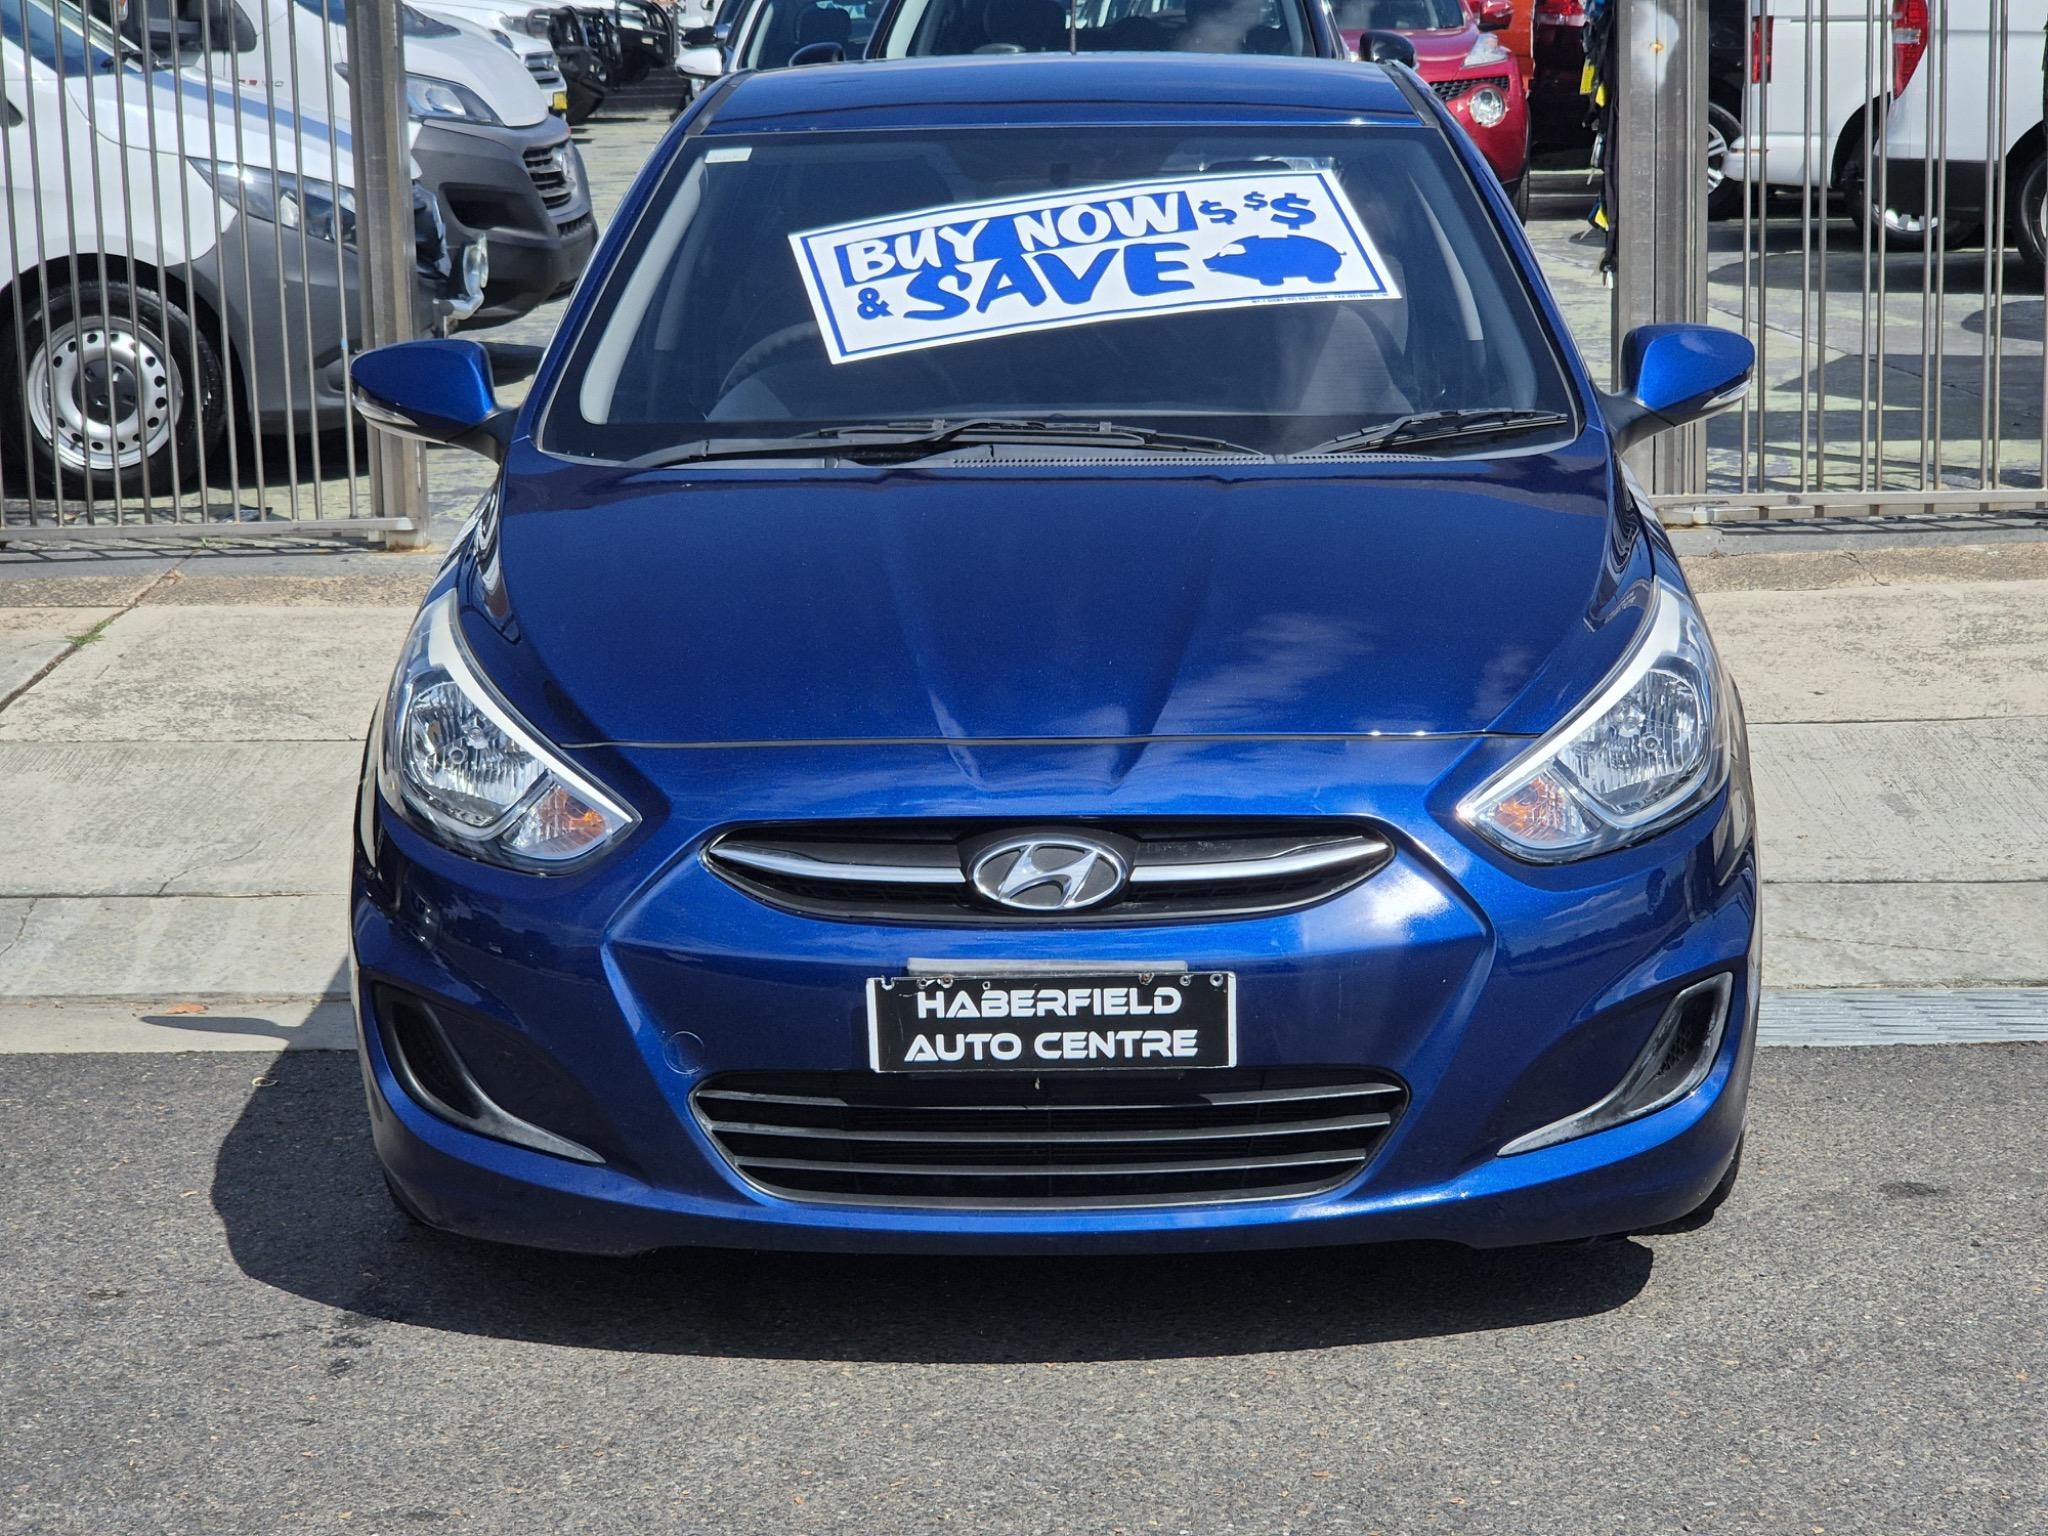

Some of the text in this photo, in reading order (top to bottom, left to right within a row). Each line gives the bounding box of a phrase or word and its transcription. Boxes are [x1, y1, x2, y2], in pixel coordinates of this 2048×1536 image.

[846, 219, 989, 282] BUY
[1013, 193, 1178, 252] NOW
[857, 242, 1195, 321] & SAVE
[917, 987, 1182, 1018] HABERFIELD
[904, 1029, 1198, 1062] AUTO CENTRE
